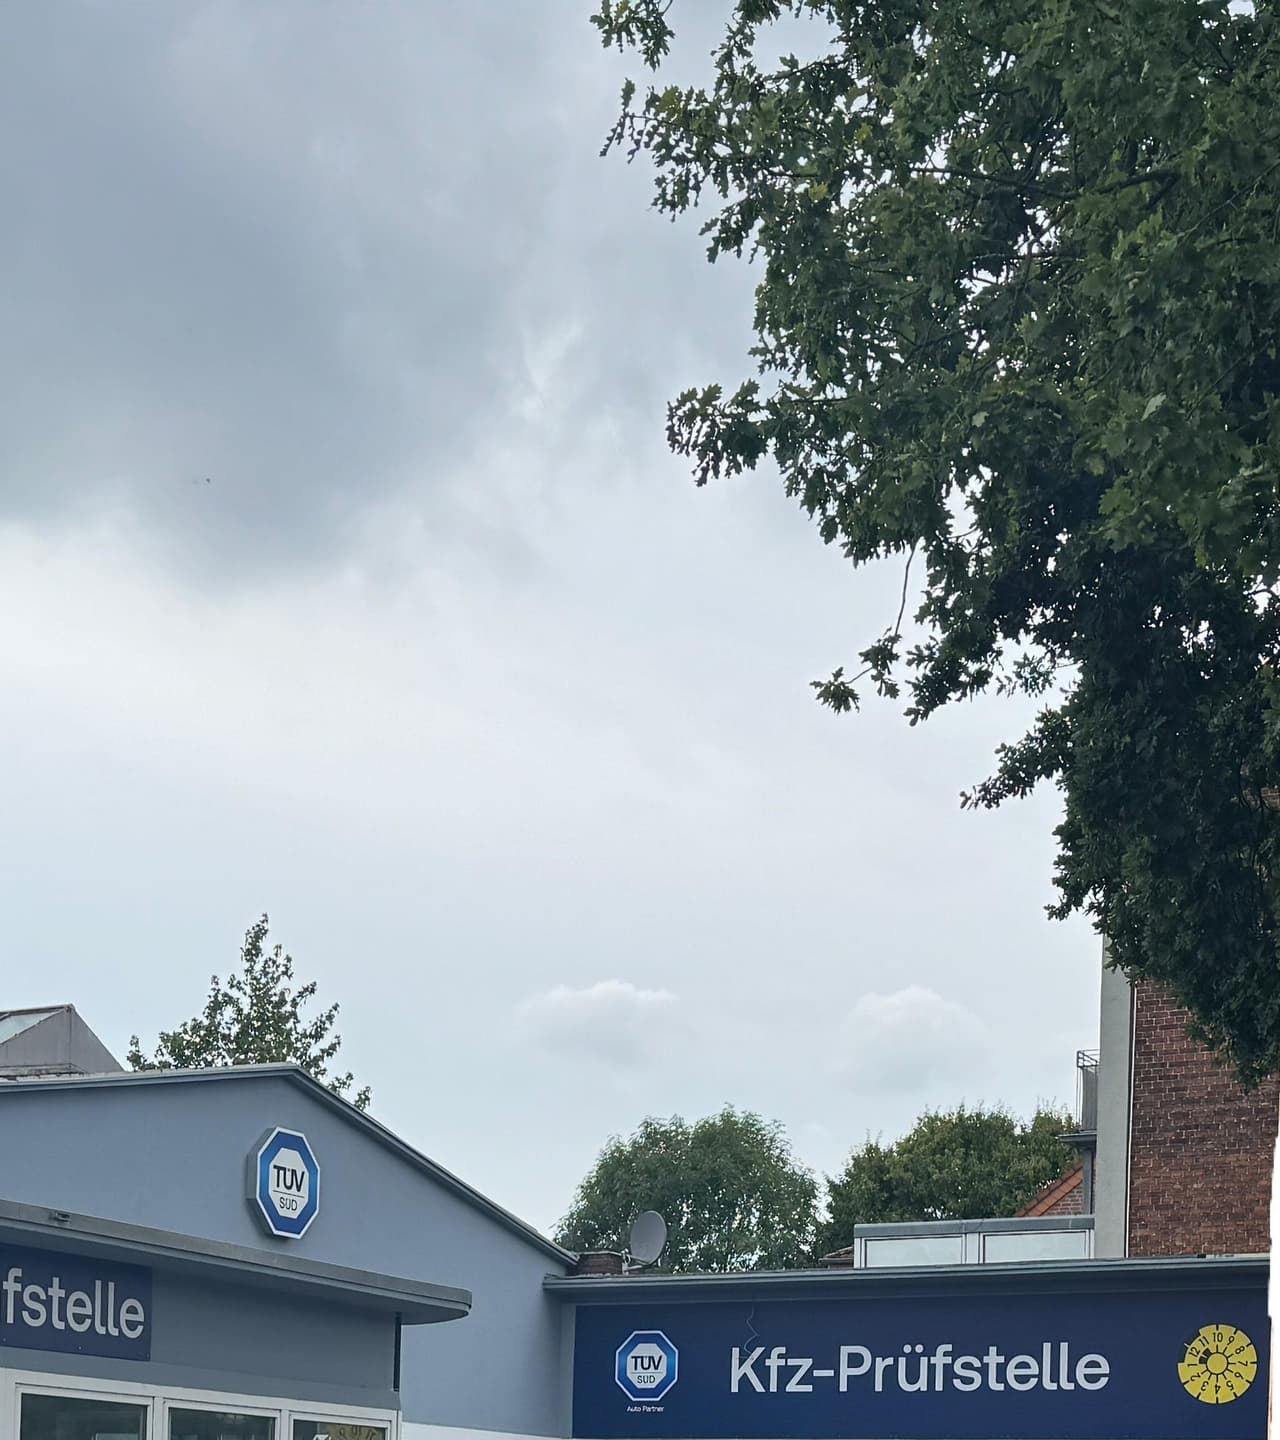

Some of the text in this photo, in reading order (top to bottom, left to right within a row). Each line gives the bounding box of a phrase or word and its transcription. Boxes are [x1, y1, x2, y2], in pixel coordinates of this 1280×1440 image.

[273, 1164, 305, 1192] TÜV
[279, 1197, 298, 1211] SÜD
[1199, 1336, 1209, 1347] 11
[1213, 1332, 1223, 1342] 10
[1227, 1336, 1235, 1345] 9
[1189, 1347, 1200, 1357] 12
[1235, 1346, 1245, 1354] 8
[631, 1355, 662, 1371] TÜV
[730, 1342, 1110, 1393] Kfz-Prüfstelle
[637, 1375, 656, 1384] SÜD
[1191, 1373, 1201, 1381] 2
[1234, 1372, 1244, 1380] 6
[1201, 1381, 1209, 1391] 3
[1215, 1384, 1221, 1394] 4
[1226, 1380, 1234, 1391] 5
